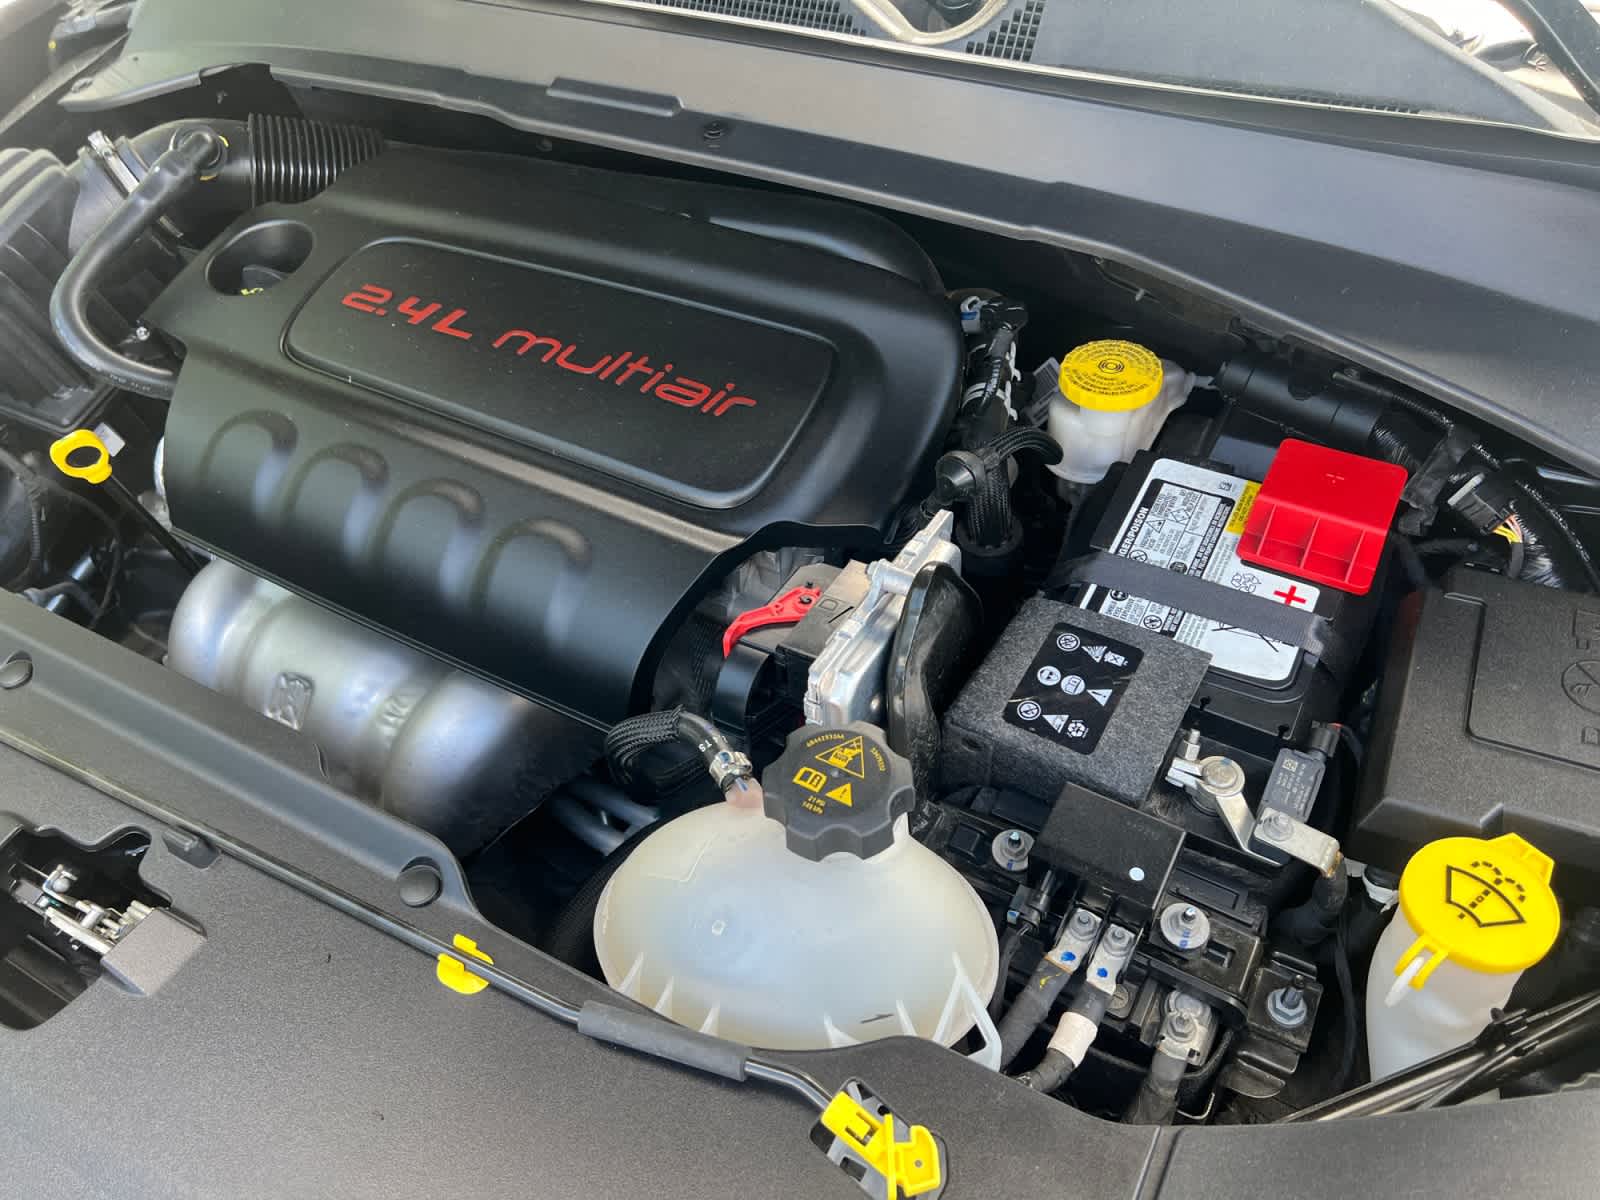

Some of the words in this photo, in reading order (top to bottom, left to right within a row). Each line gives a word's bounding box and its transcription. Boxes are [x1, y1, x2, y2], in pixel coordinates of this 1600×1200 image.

[342, 284, 472, 340] 2.4L
[492, 329, 757, 417] multiair
[1118, 506, 1149, 557] GER/POISON
